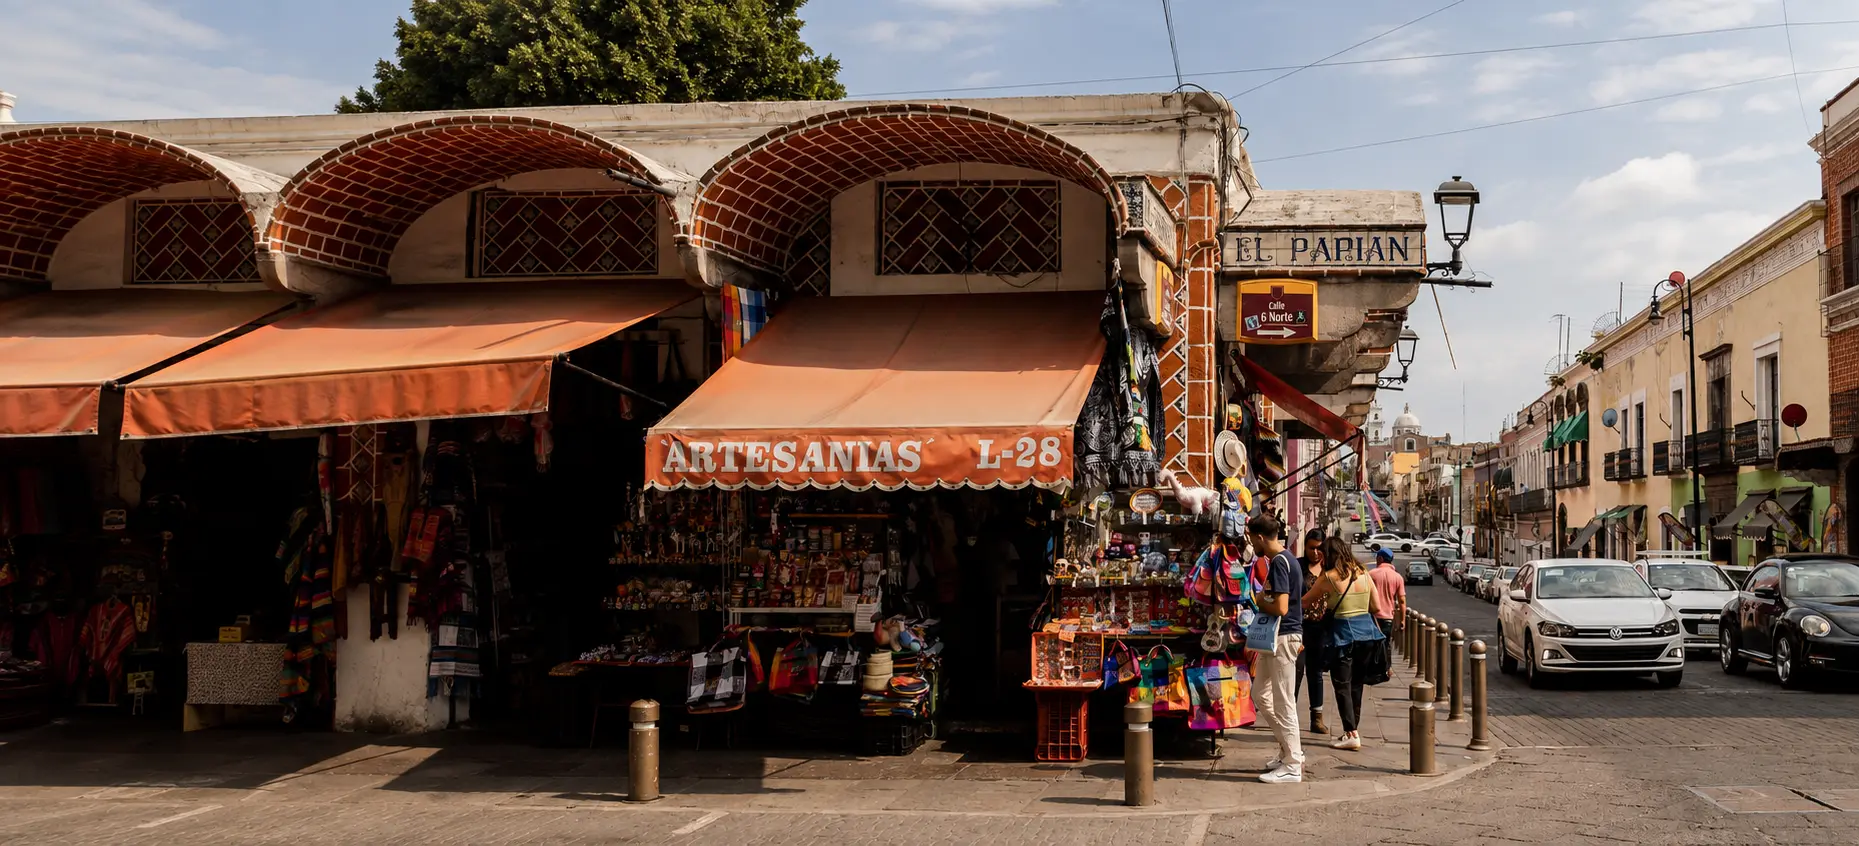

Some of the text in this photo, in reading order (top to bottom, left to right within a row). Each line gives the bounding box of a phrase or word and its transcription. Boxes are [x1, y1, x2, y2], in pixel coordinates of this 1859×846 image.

[1235, 237, 1273, 262] EL
[1268, 301, 1285, 310] Calle
[1260, 311, 1293, 322] 6 Norte
[976, 436, 1062, 469] L-28
